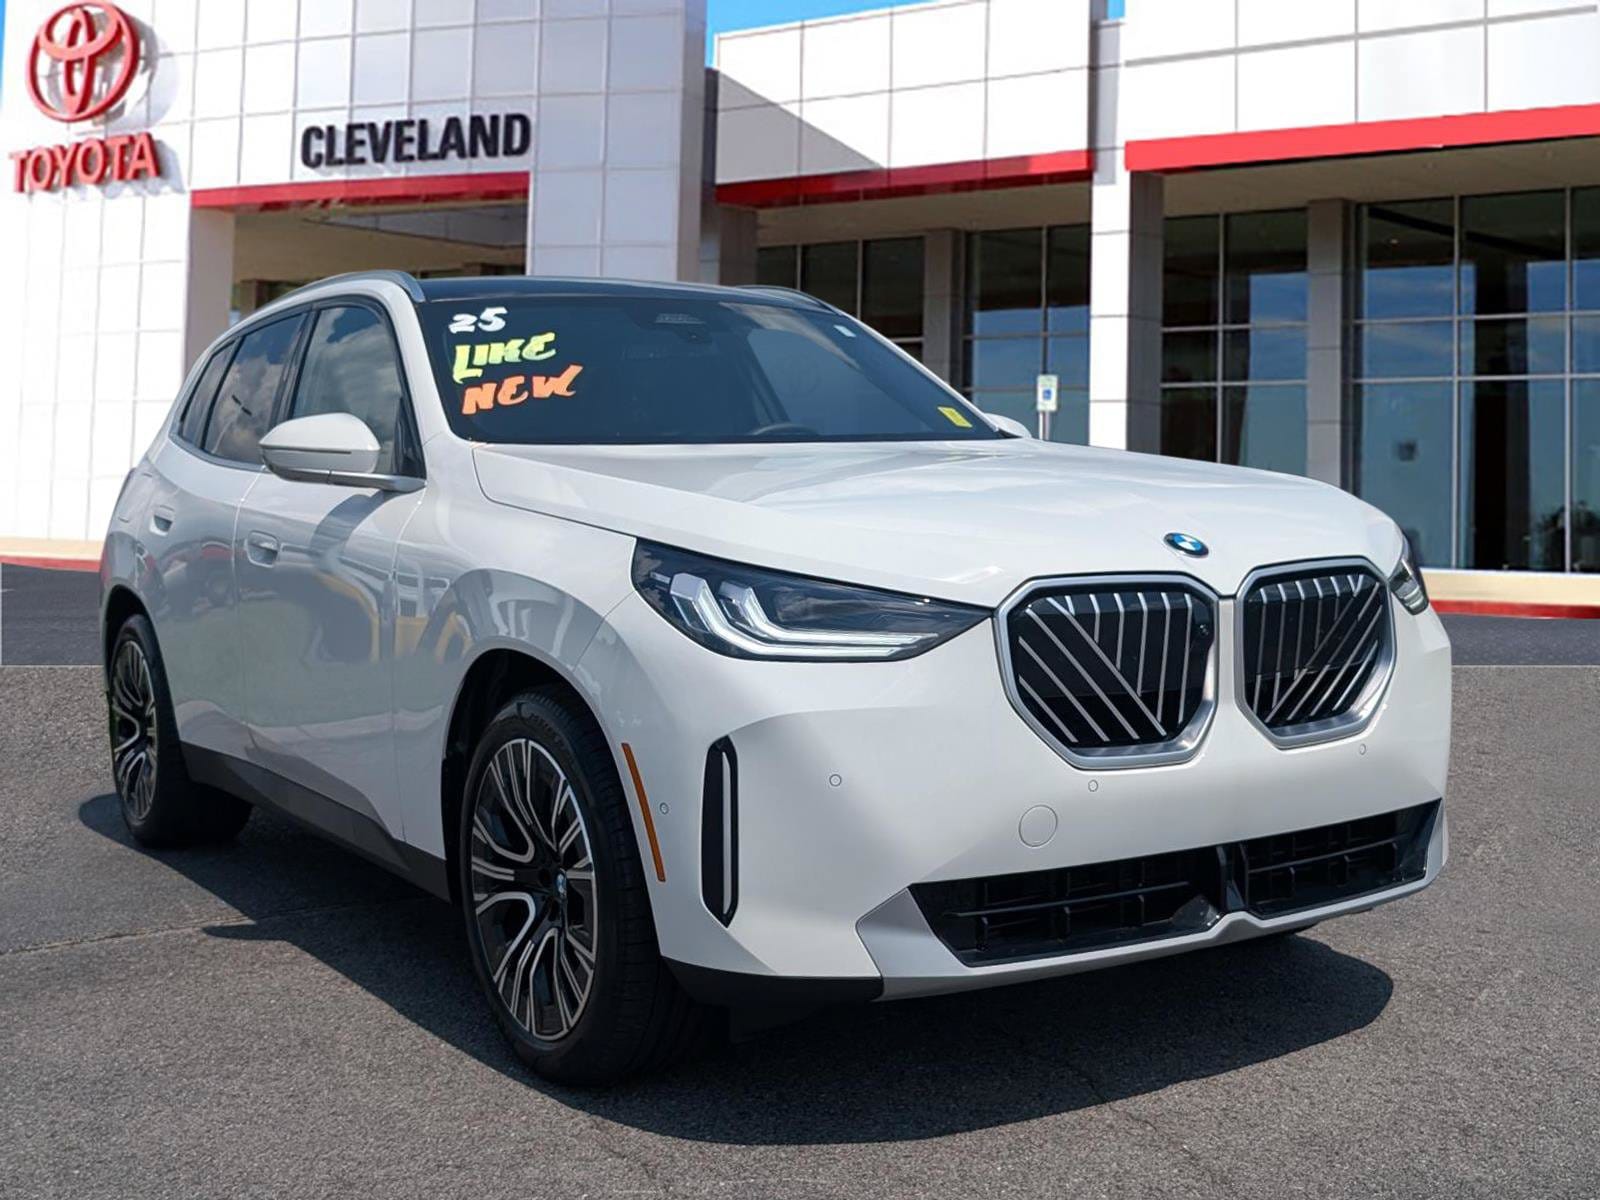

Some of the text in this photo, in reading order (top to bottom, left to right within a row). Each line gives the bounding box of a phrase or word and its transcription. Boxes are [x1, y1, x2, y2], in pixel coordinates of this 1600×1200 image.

[9, 132, 162, 194] TOYOTA
[301, 113, 532, 169] CLEVELAND
[448, 306, 508, 334] 25
[452, 332, 556, 384] LIKE
[462, 364, 583, 415] NEW
